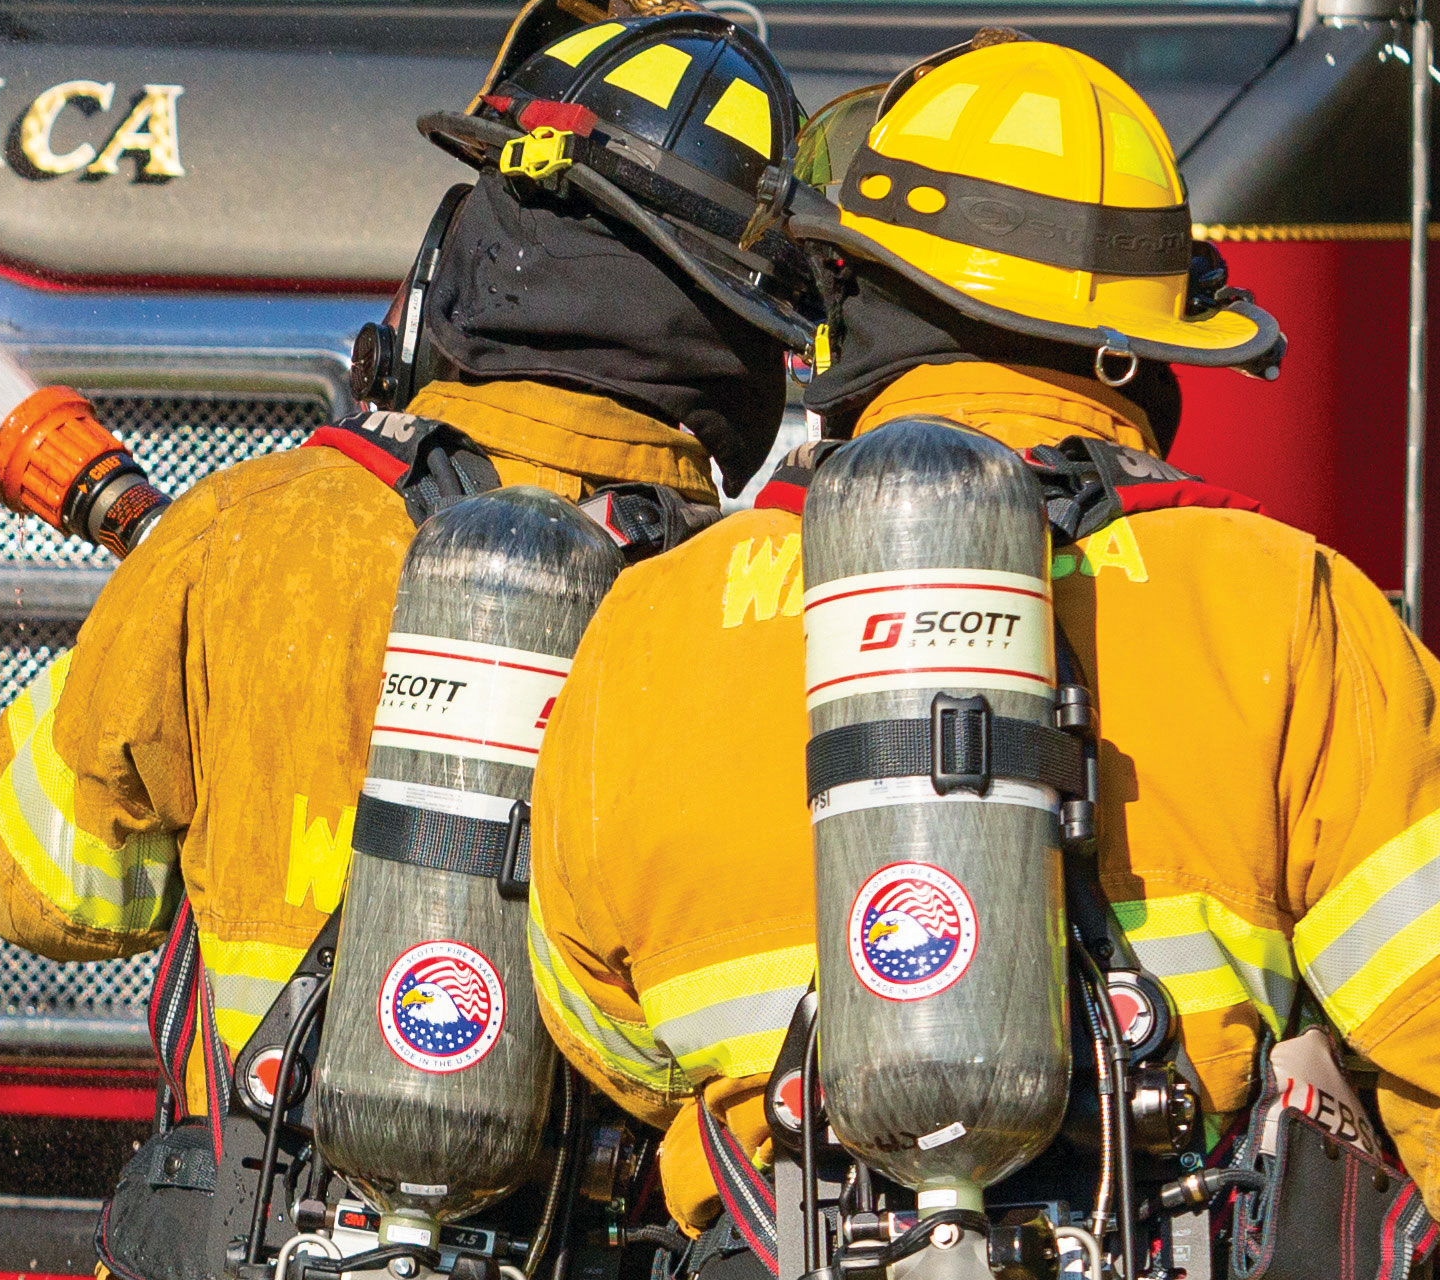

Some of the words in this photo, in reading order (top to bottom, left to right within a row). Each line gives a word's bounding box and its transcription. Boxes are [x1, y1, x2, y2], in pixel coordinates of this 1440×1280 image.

[913, 611, 1021, 637] SCOTT
[908, 638, 1010, 650] SAFETY
[386, 673, 467, 702] SCOTT
[382, 698, 449, 714] SAFETY
[814, 790, 830, 813] PSI
[447, 946, 468, 959] FIRE
[477, 962, 499, 996] SAFETY
[393, 1038, 416, 1059] MADE
[419, 1057, 429, 1066] IN
[433, 1060, 453, 1068] THE
[344, 1212, 367, 1227] 3M
[455, 1232, 478, 1246] 4.5
